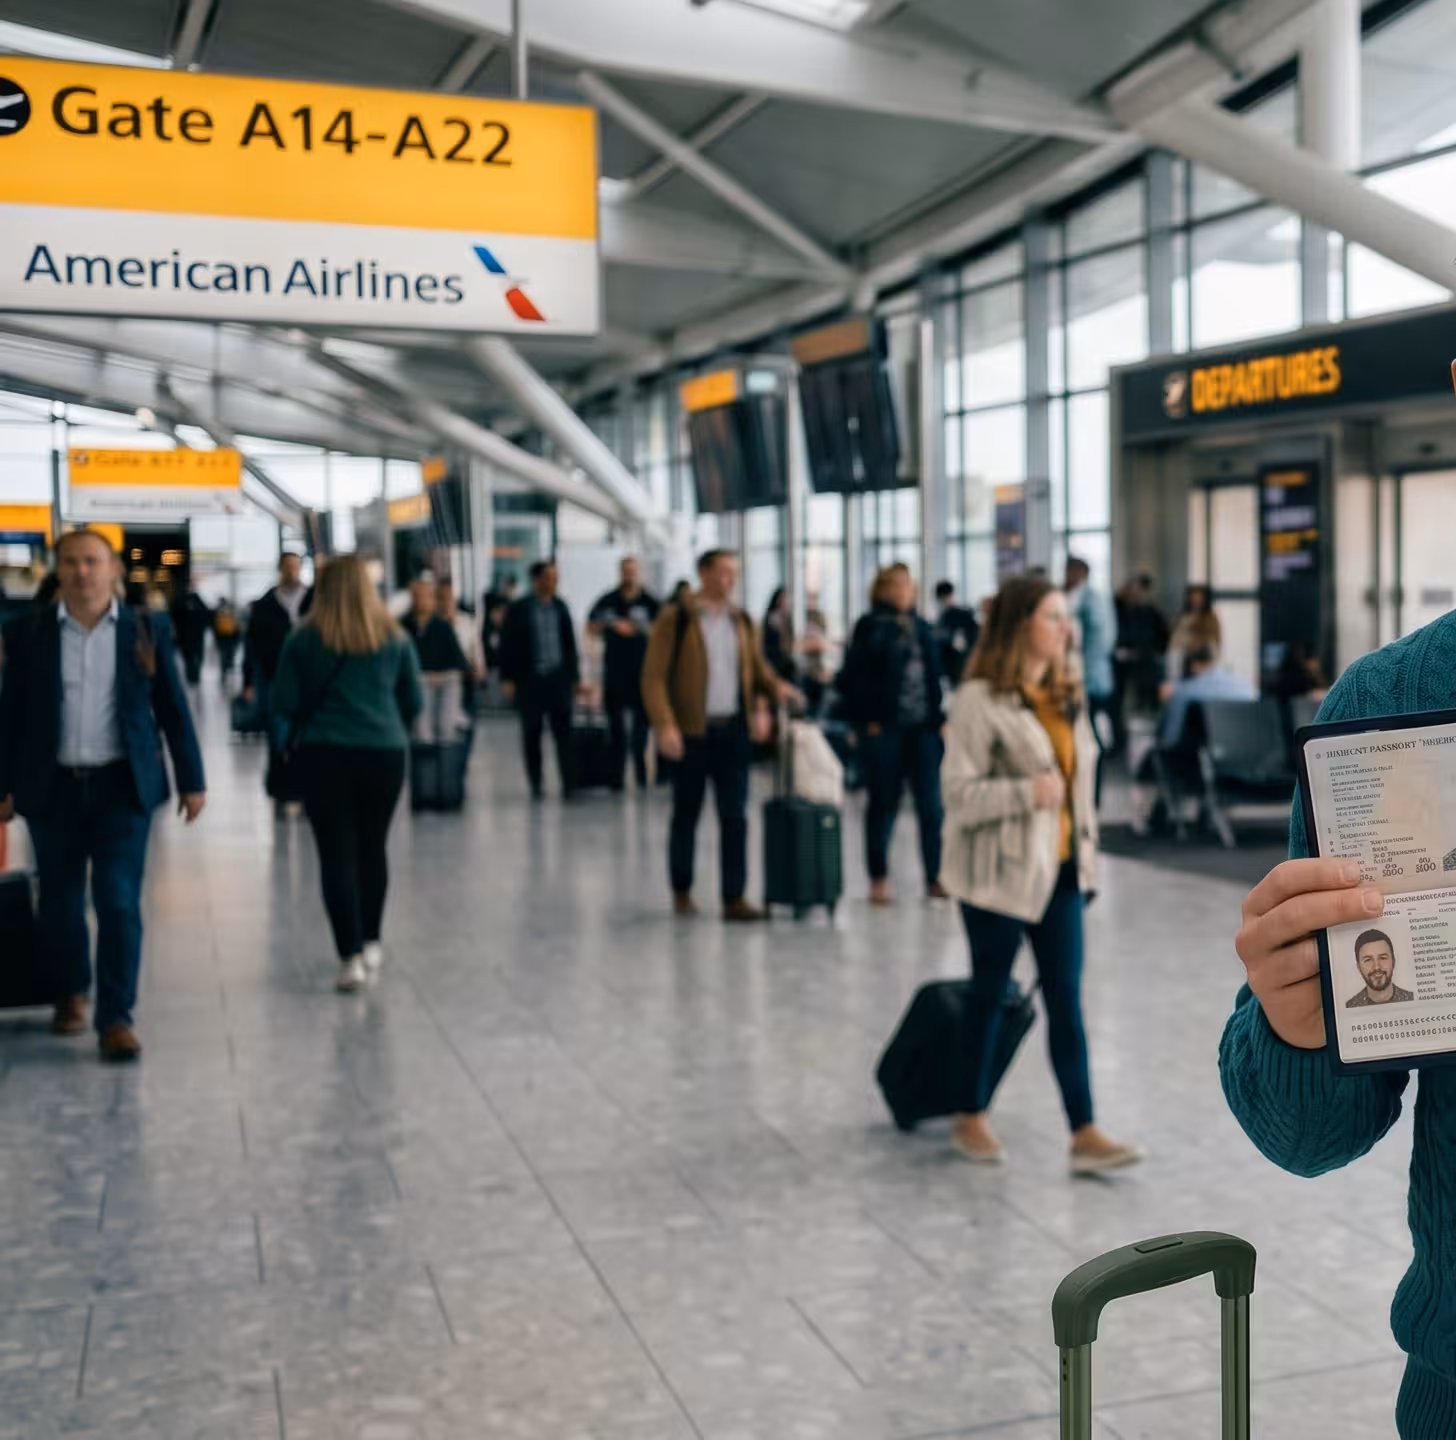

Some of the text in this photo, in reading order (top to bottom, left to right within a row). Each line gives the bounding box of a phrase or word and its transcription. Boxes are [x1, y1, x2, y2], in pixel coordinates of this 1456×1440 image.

[51, 85, 514, 167] Gate A14-A22
[23, 244, 465, 304] American Airlines
[1190, 345, 1342, 413] DEPARTURES
